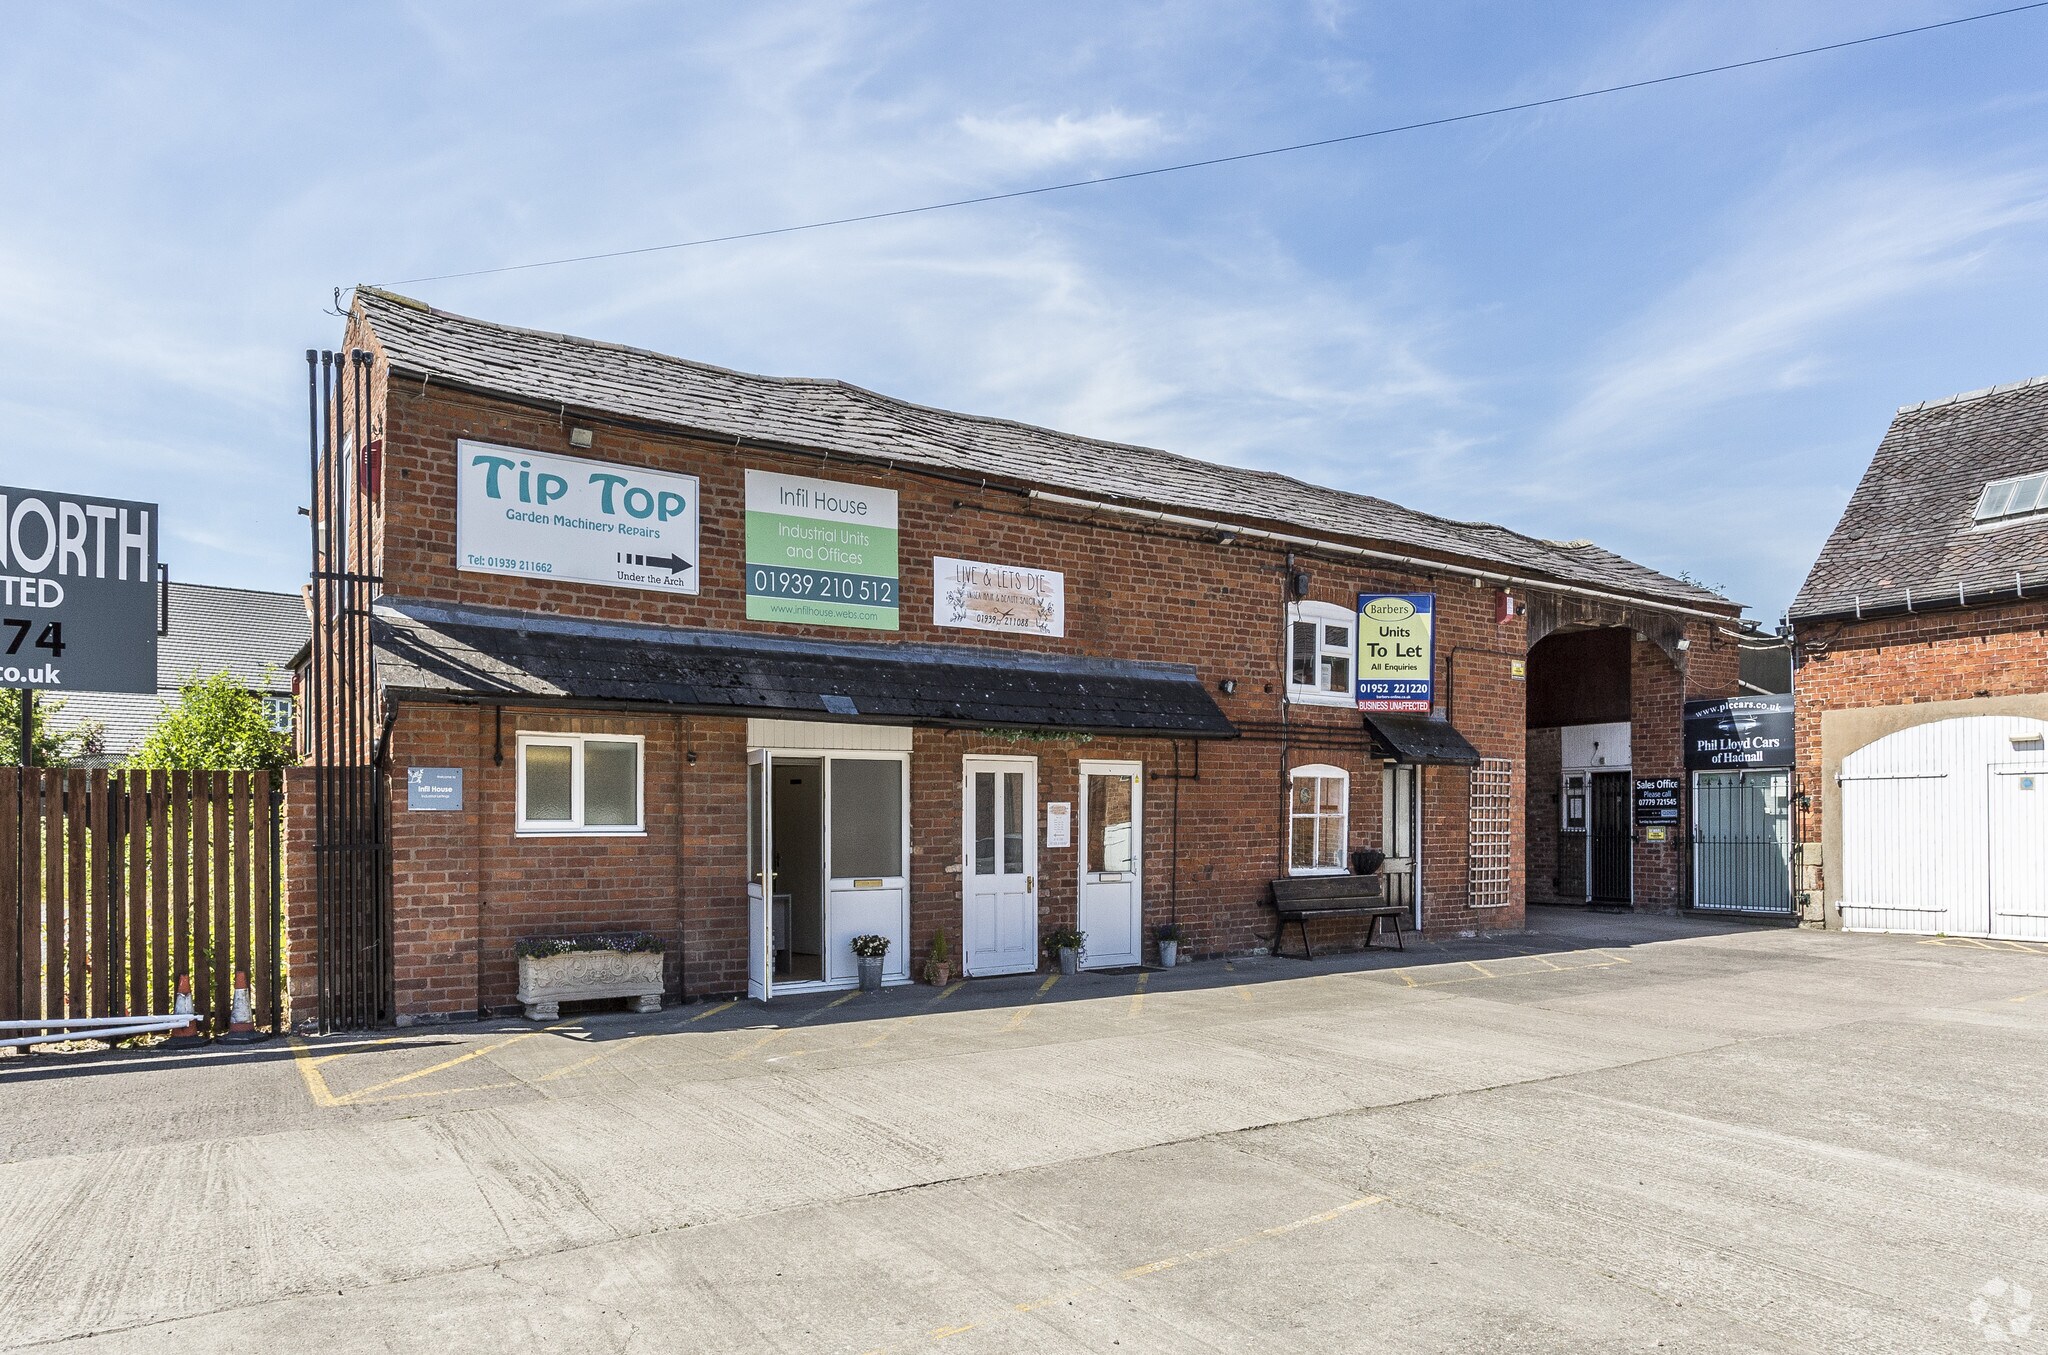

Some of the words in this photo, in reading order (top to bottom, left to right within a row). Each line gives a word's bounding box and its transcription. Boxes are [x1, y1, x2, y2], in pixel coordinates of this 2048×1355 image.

[472, 455, 568, 505] Tip
[588, 473, 686, 522] Top
[780, 486, 808, 508] Infil
[814, 491, 867, 516] House
[506, 508, 549, 524] Garden
[554, 514, 614, 532] Machinery
[618, 523, 660, 538] Repairs
[0, 494, 148, 582] ORTH
[778, 522, 837, 542] Industrial
[840, 530, 869, 547] Units
[468, 554, 485, 566] Tel:
[488, 557, 516, 569] 01939
[519, 561, 552, 573] 211662
[786, 546, 814, 559] and
[817, 547, 863, 565] Offices
[617, 571, 645, 582] Under
[647, 575, 661, 584] the
[663, 576, 684, 586] Arch
[956, 564, 977, 585] LIVE
[983, 568, 992, 587] &
[997, 569, 1021, 590] LETS
[754, 570, 814, 595] 01939
[820, 576, 854, 599] 210
[859, 581, 892, 602] 512
[770, 604, 878, 621] www.infilhouse.webs.com
[1370, 604, 1409, 614] Barbers
[976, 613, 997, 624] 01939
[1004, 616, 1029, 628] 211088
[4, 618, 66, 657] 74
[1379, 626, 1411, 638] Units
[1366, 642, 1388, 658] To
[1396, 642, 1423, 658] Let
[1384, 663, 1418, 672] Enquiries
[1360, 684, 1389, 693] 01952
[1394, 684, 1428, 694] 221220
[1360, 702, 1388, 710] BUSINESS
[1390, 702, 1428, 710] UNAFFECTED
[1697, 739, 1718, 751] Phil
[1720, 737, 1751, 752] Lloyd
[1752, 736, 1780, 749] Cars
[1711, 752, 1722, 764] of
[1723, 750, 1763, 763] Hadnall
[1636, 780, 1655, 790] Sales
[1656, 779, 1678, 789] Office
